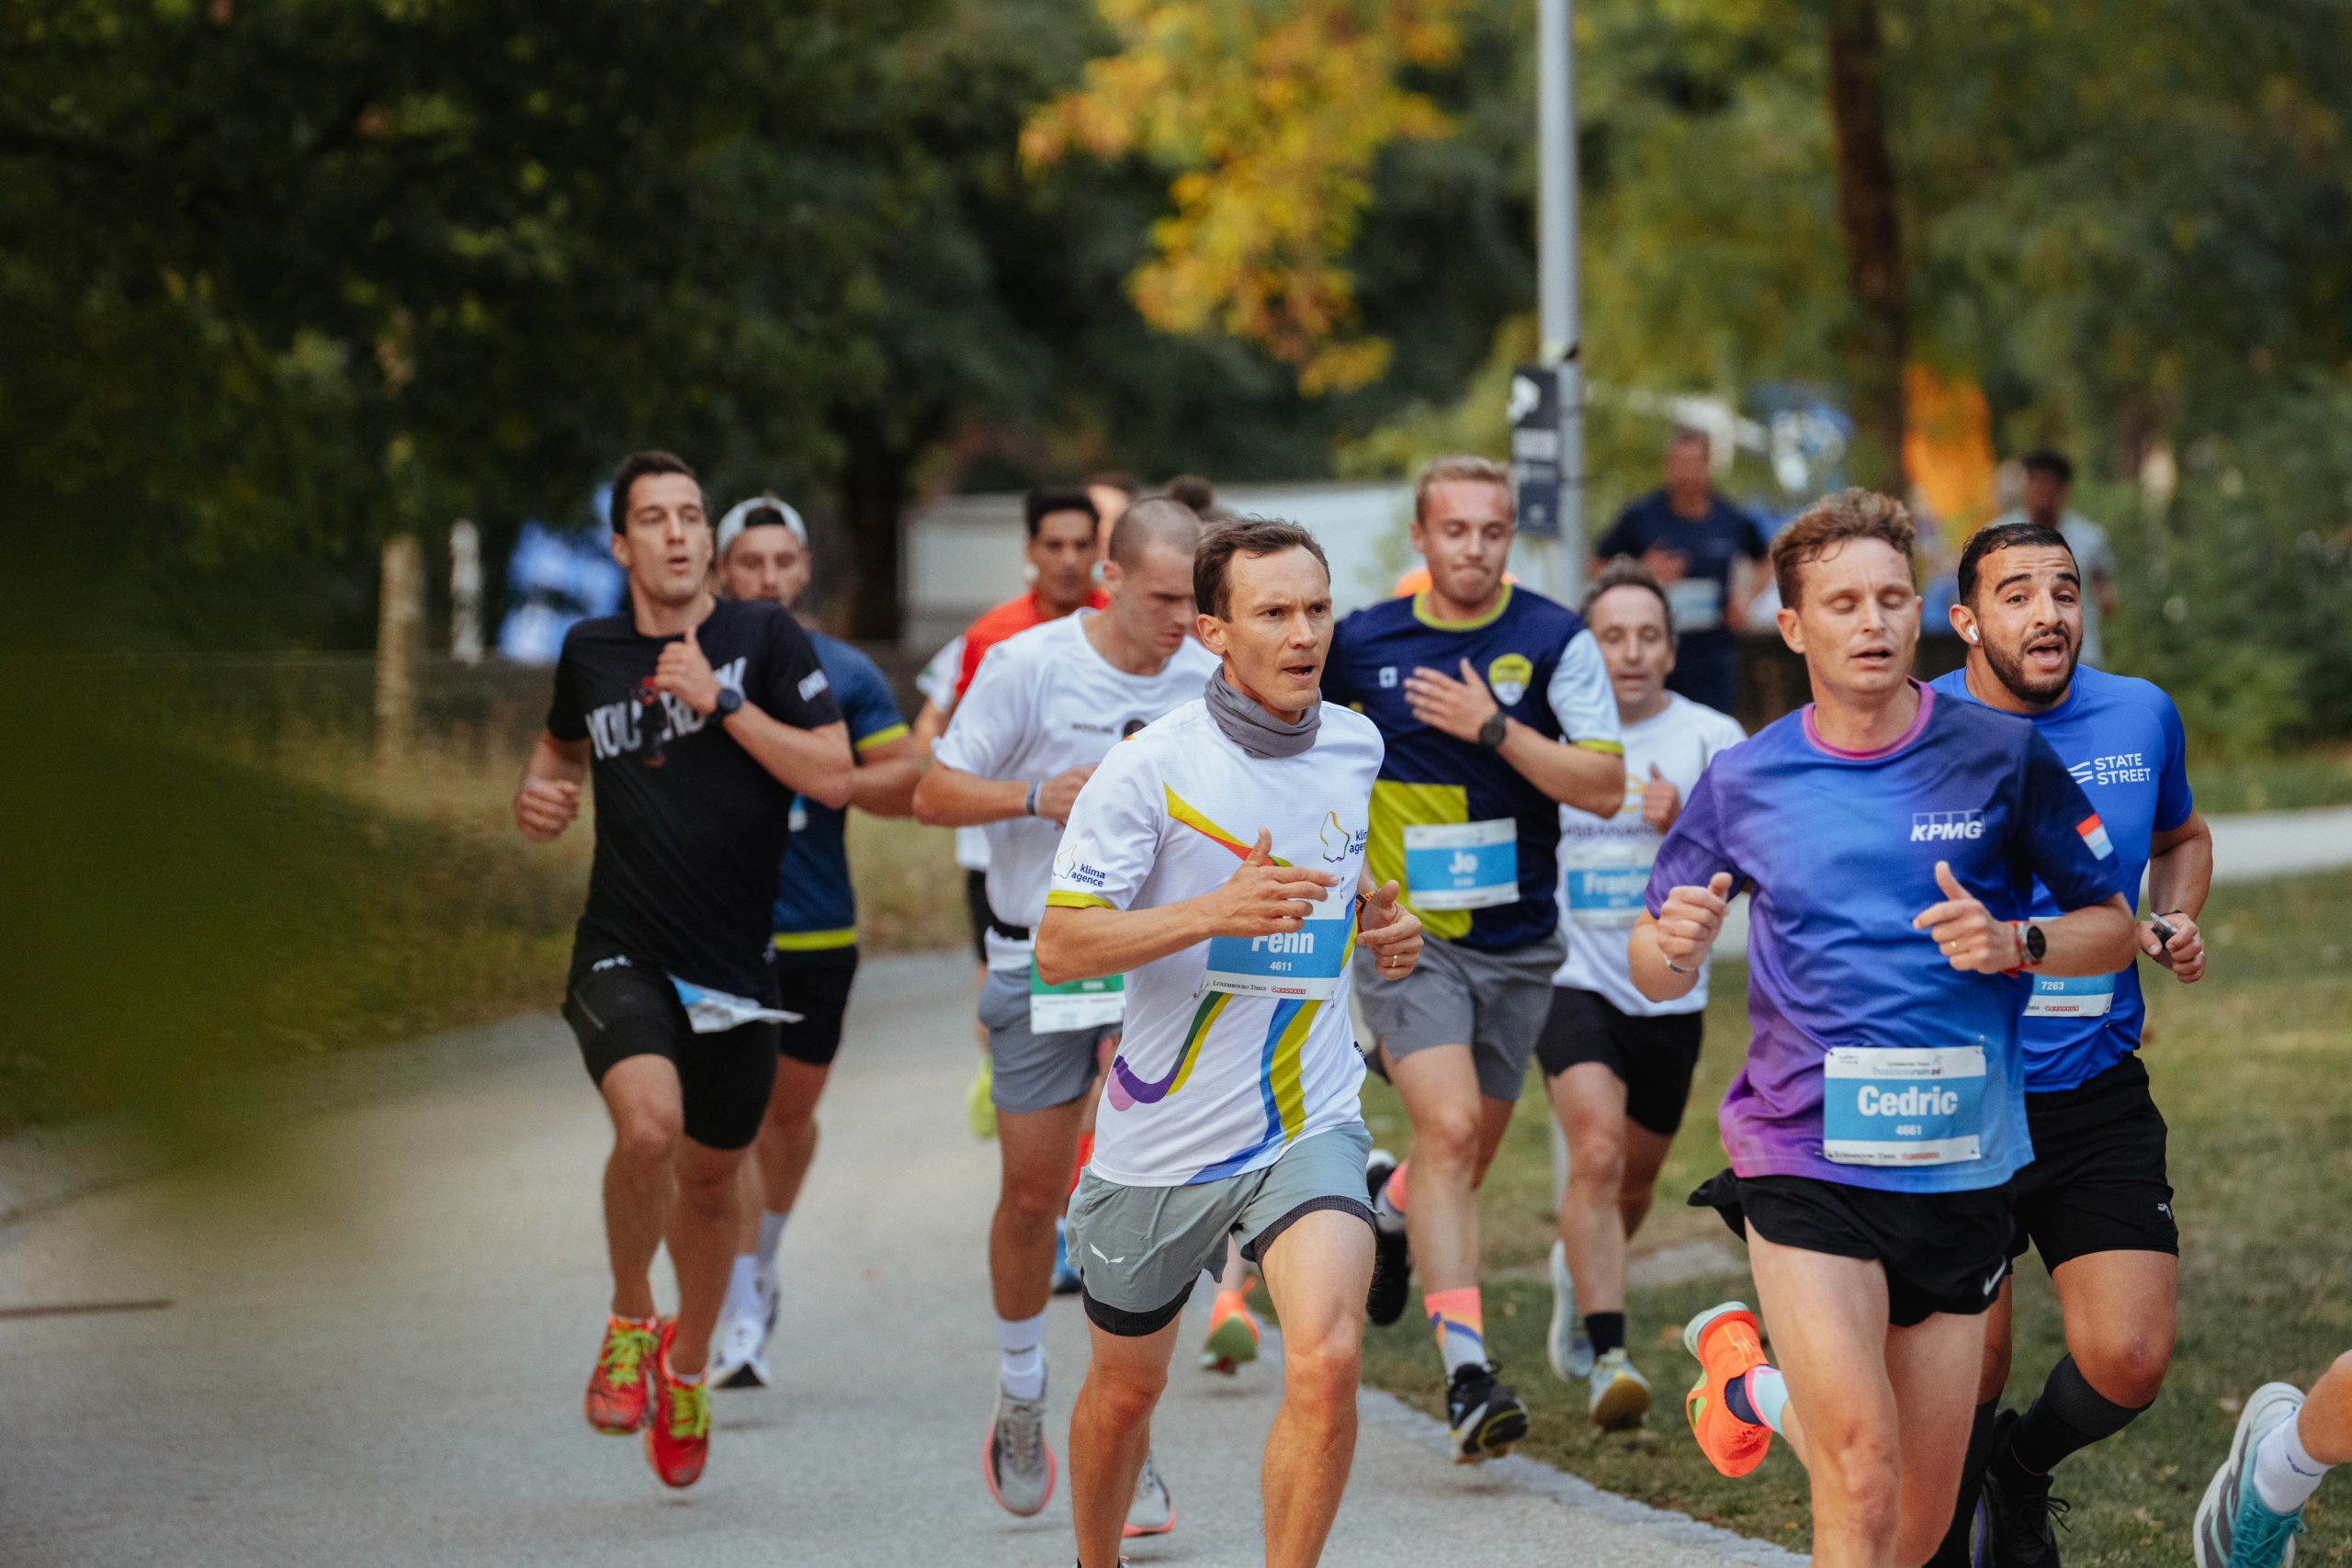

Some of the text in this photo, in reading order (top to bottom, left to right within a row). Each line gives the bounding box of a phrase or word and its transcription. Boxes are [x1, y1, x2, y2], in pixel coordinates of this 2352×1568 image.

[2095, 753, 2143, 771] STATE
[2097, 768, 2151, 785] STREET
[1910, 820, 1984, 842] KPMG
[1080, 863, 1106, 880] klima
[1448, 850, 1478, 876] Jo
[1070, 872, 1104, 887] agence
[1269, 961, 1292, 972] 4611
[2041, 981, 2065, 991] 7263
[1858, 1085, 1959, 1117] Cedric
